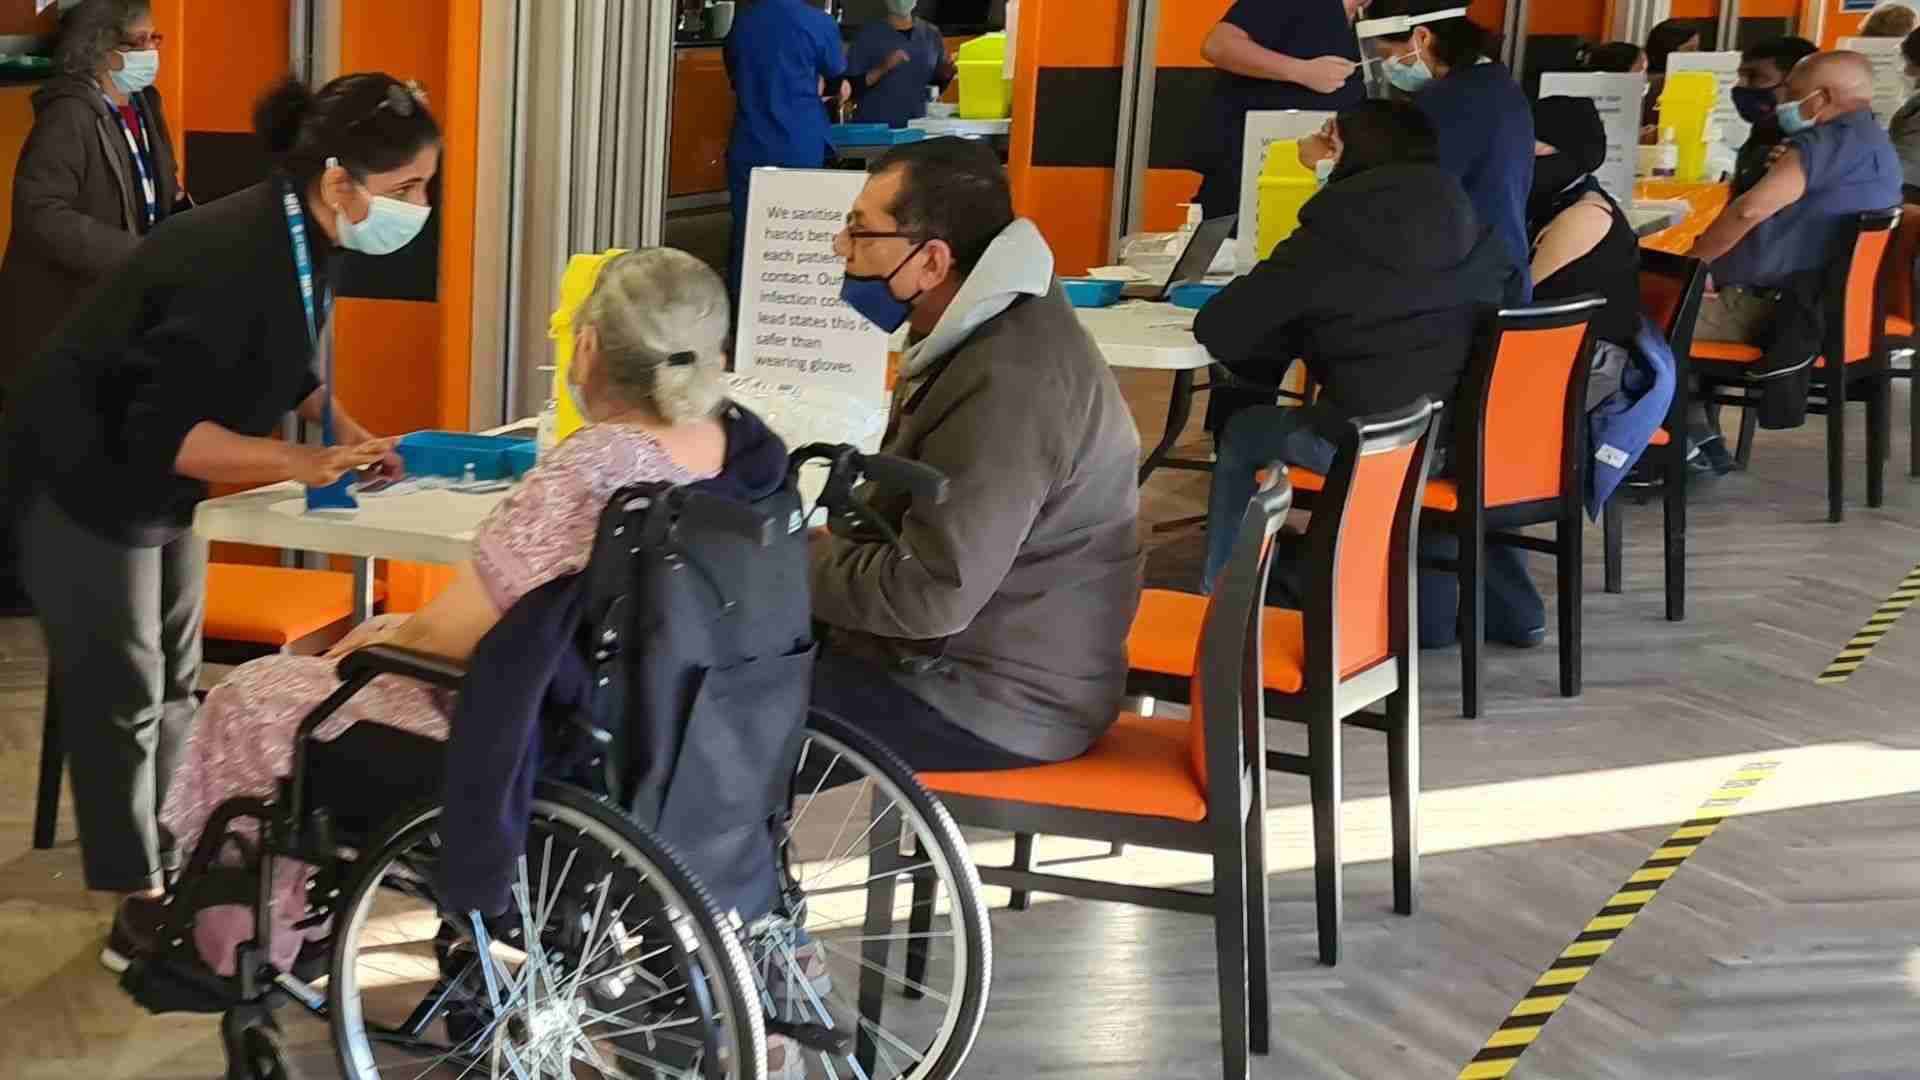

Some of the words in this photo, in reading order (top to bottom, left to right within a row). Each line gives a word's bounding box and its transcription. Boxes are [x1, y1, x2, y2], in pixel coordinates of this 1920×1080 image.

[767, 206, 789, 220] We
[791, 209, 842, 221] sanitise
[764, 226, 803, 241] hands
[763, 250, 794, 262] each
[759, 291, 817, 305] infection
[757, 312, 787, 326] lead
[789, 315, 828, 329] states
[831, 317, 857, 331] this
[756, 333, 788, 347] safer
[791, 335, 822, 350] than
[755, 356, 806, 372] wearing
